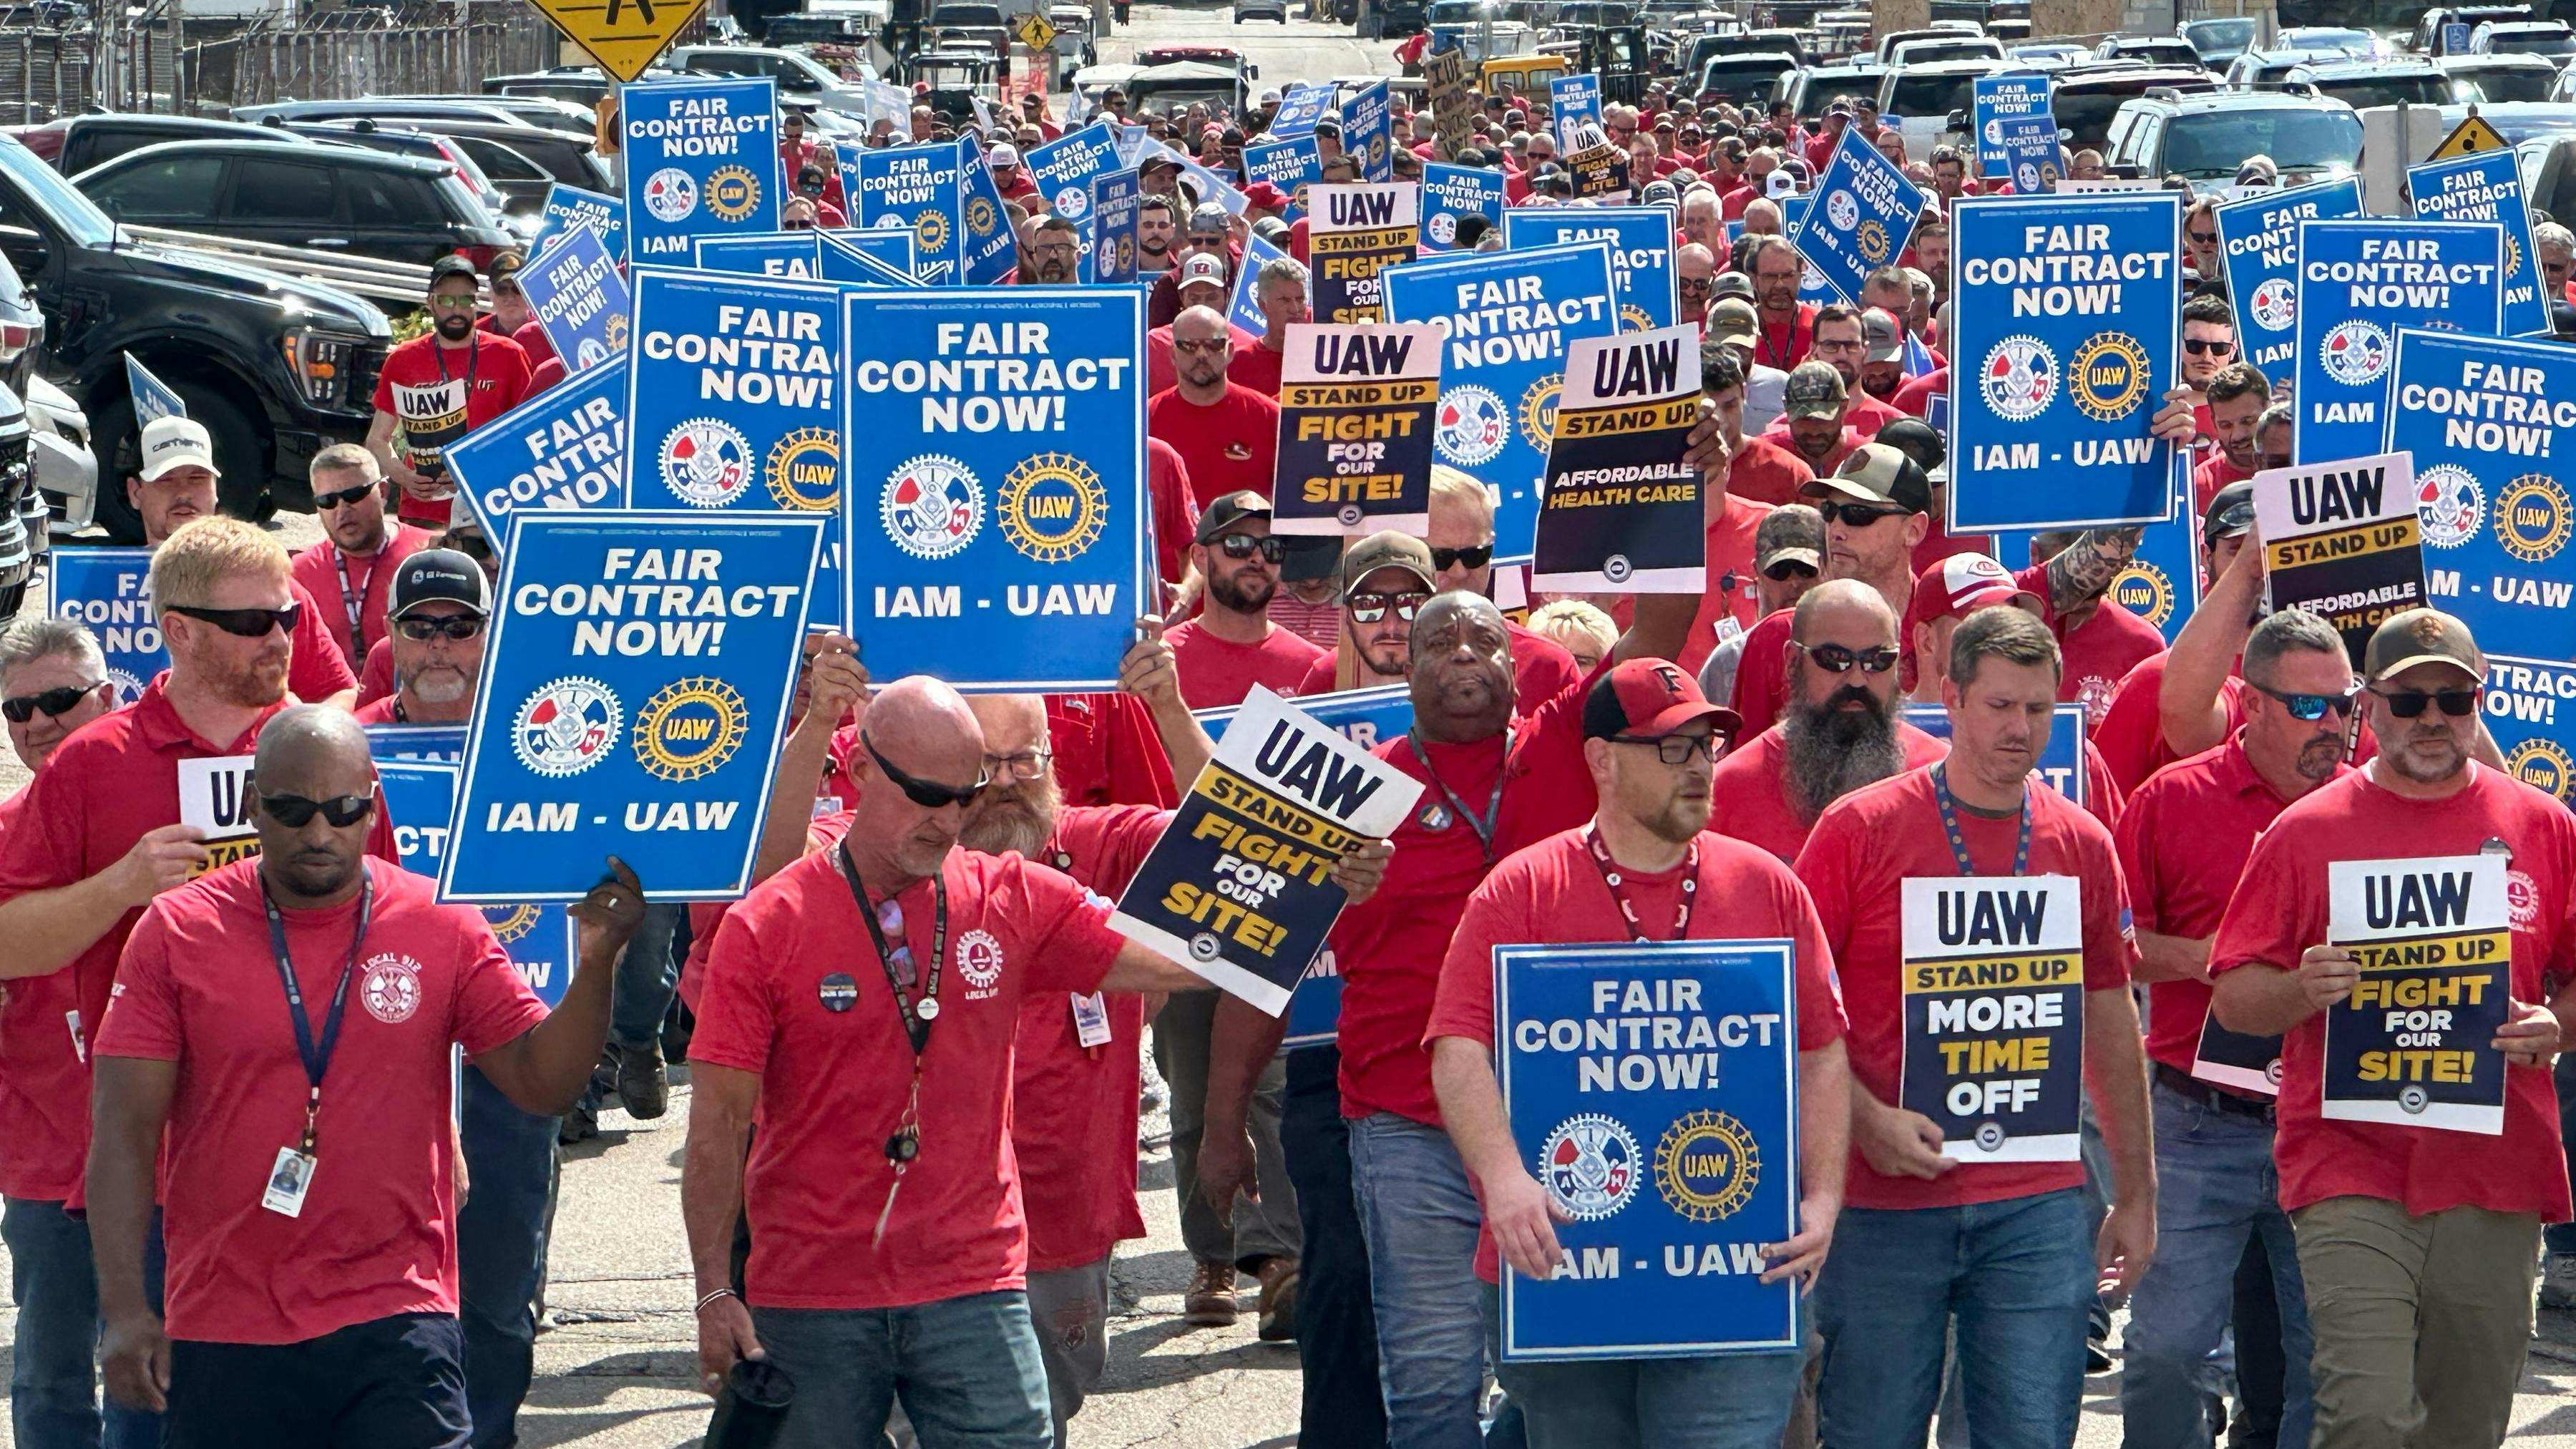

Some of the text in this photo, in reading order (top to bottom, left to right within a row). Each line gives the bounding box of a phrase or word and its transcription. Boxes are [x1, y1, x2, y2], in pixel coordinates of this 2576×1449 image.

[1978, 93, 2047, 104] CONTRACT
[1997, 85, 2026, 94] FAIR
[669, 98, 728, 117] FAIR
[1344, 100, 1389, 134] CONTRACT
[1994, 103, 2031, 113] NOW!
[628, 114, 770, 139] CONTRACT
[663, 137, 738, 157] NOW!
[1035, 141, 1111, 179] CONTRACT
[1053, 140, 1085, 161] FAIR
[1267, 148, 1295, 162] FAIR
[889, 157, 928, 174] FAIR
[1056, 159, 1100, 184] NOW!
[1250, 153, 1317, 176] CONTRACT
[1268, 167, 1304, 182] NOW!
[1867, 158, 1898, 193] FAIR
[863, 170, 956, 192] CONTRACT
[885, 186, 934, 205] NOW!
[1425, 183, 1501, 203] CONTRACT
[1448, 175, 1480, 188] FAIR
[1840, 150, 1915, 223] CONTRACT
[2442, 170, 2485, 192] FAIR
[575, 200, 611, 217] FAIR
[1330, 192, 1395, 225] UAW
[1443, 195, 1483, 210] NOW!
[1851, 177, 1894, 221] NOW!
[2417, 181, 2517, 214] CONTRACT
[549, 204, 621, 230] CONTRAC
[2262, 203, 2318, 229] FAIR
[643, 236, 688, 253] IAM
[982, 233, 1010, 258] UAW
[1319, 232, 1407, 250] STAND UP
[1812, 220, 1838, 250] IAM
[1847, 254, 1872, 280] UA
[2025, 225, 2109, 253] FAIR
[2228, 226, 2296, 256] CONT
[2362, 240, 2440, 260] FAIR
[549, 254, 580, 287] FAIR
[1964, 253, 2170, 286] CONTRACT
[2306, 262, 2494, 285] CONTRACT
[540, 255, 610, 324] CONTRACT
[1353, 295, 1380, 305] OUR
[1457, 275, 1543, 310] FAIR
[2012, 286, 2122, 317] NOW!
[2350, 285, 2449, 308] NOW!
[2506, 286, 2532, 306] AW
[565, 291, 608, 331] NOW!
[718, 306, 821, 341] FAIR
[644, 331, 836, 375] CONTRA
[937, 322, 1050, 355] FAIR
[1452, 330, 1563, 370] NOW!
[1314, 334, 1413, 375] UAW
[1594, 338, 1679, 397] UAW
[700, 369, 832, 409] NOW!
[857, 358, 1129, 393] CONTRACT
[2092, 367, 2126, 386] UAW
[2462, 361, 2545, 396] FAIR
[403, 389, 449, 416] UAW
[1293, 385, 1425, 405] STAND UP
[2401, 384, 2576, 427] CONTRAC
[446, 411, 462, 426] UP
[525, 396, 617, 460] FAIR
[922, 396, 1065, 434] NOW!
[1297, 411, 1420, 441] FIGHT
[1565, 410, 1657, 434] STAND
[1665, 402, 1695, 425] UP
[2314, 402, 2374, 424] IAM
[1327, 442, 1385, 462] FOR
[2445, 419, 2552, 458] NOW!
[1335, 461, 1375, 475] OUR
[1974, 444, 2040, 472] IAM
[2073, 438, 2155, 467] UAW
[1303, 474, 1402, 502] SITE!
[1555, 463, 1694, 488] AFFORDABLE
[1028, 496, 1074, 519] UAW
[1549, 488, 1631, 509] HEALTH
[1636, 485, 1696, 505] CARE
[2289, 467, 2384, 526] UAW
[2517, 507, 2550, 528] UAW
[2278, 525, 2408, 565] STAND UP
[603, 548, 723, 580] FAIR
[514, 584, 799, 618] CONTRACT
[874, 585, 961, 618] IAM
[1007, 583, 1116, 616] UAW
[2119, 588, 2152, 605] UAW
[2492, 577, 2573, 609] UAW
[107, 628, 164, 653] NO
[572, 621, 726, 656] NOW!
[2487, 690, 2556, 725] OW!
[665, 718, 715, 741] UAW
[1255, 718, 1385, 821] UAW
[2524, 768, 2555, 787] UAW
[487, 803, 579, 832] IAM
[624, 801, 738, 831] UAW
[1209, 776, 1364, 855] STAND UP
[1191, 811, 1334, 887] FIGHT
[1213, 854, 1286, 898] FOR
[1216, 879, 1264, 909] OUR
[2365, 872, 2473, 929] UAW
[1161, 882, 1288, 957] SITE!
[1938, 891, 2047, 946] UAW
[361, 952, 396, 972] LOCAL
[2456, 939, 2495, 961] UP
[1917, 960, 2069, 988] STAND UP
[1592, 979, 1702, 1014] FAIR
[2351, 975, 2492, 1010] FIGHT
[1928, 994, 2064, 1035] MORE
[2385, 1010, 2453, 1033] FOR
[1515, 1013, 1780, 1053] CONTRACT
[2396, 1033, 2441, 1048] OUR
[1939, 1037, 2050, 1075] TIME
[2357, 1051, 2474, 1084] SITE!
[1579, 1053, 1719, 1092] NOW!
[1946, 1078, 2041, 1116] OFF
[1684, 1153, 1727, 1178] UAW
[1551, 1247, 1619, 1280] AM
[1664, 1244, 1767, 1277] UAW
